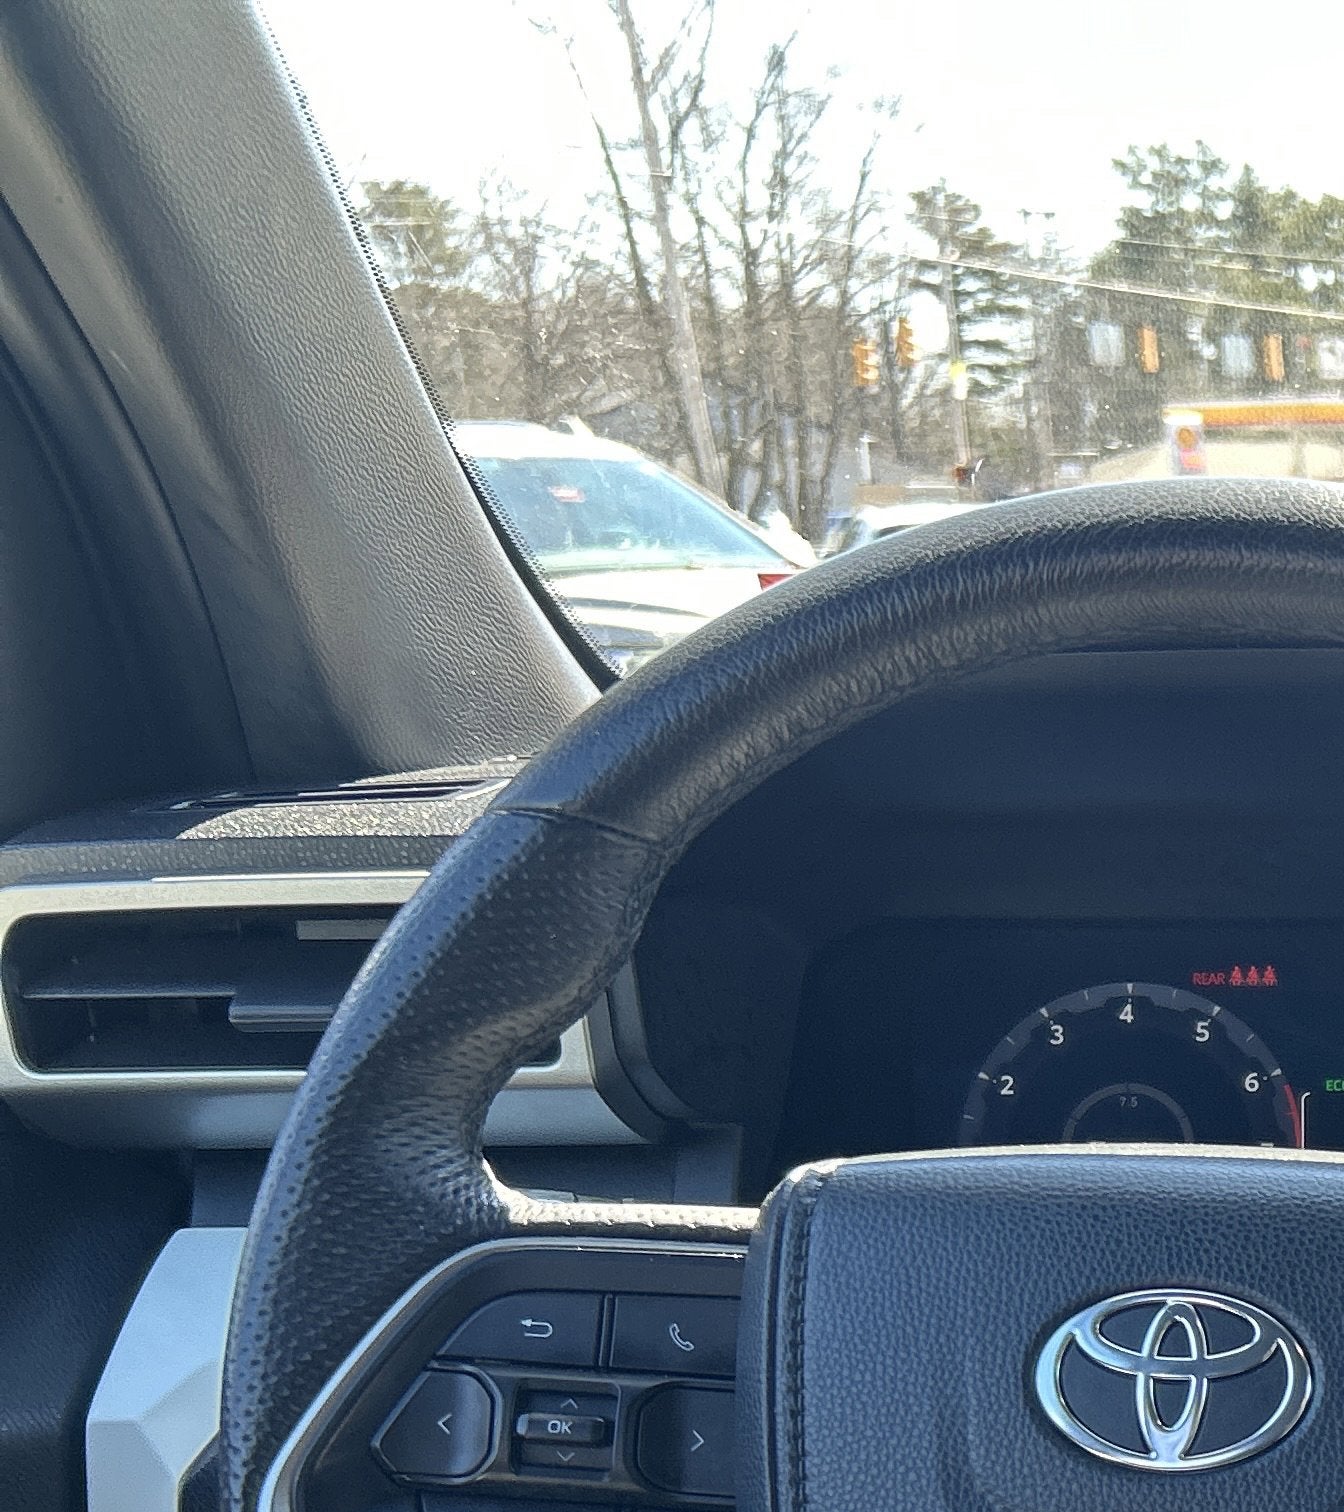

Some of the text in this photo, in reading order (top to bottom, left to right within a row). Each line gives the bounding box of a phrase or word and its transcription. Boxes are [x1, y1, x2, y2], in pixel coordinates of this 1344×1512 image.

[1192, 972, 1225, 985] REAR
[1119, 1004, 1133, 1023] 4
[1050, 1025, 1064, 1045] 3
[1196, 1022, 1210, 1042] 5
[1001, 1075, 1014, 1095] 2
[1245, 1072, 1259, 1092] 6
[548, 1420, 573, 1434] OK
